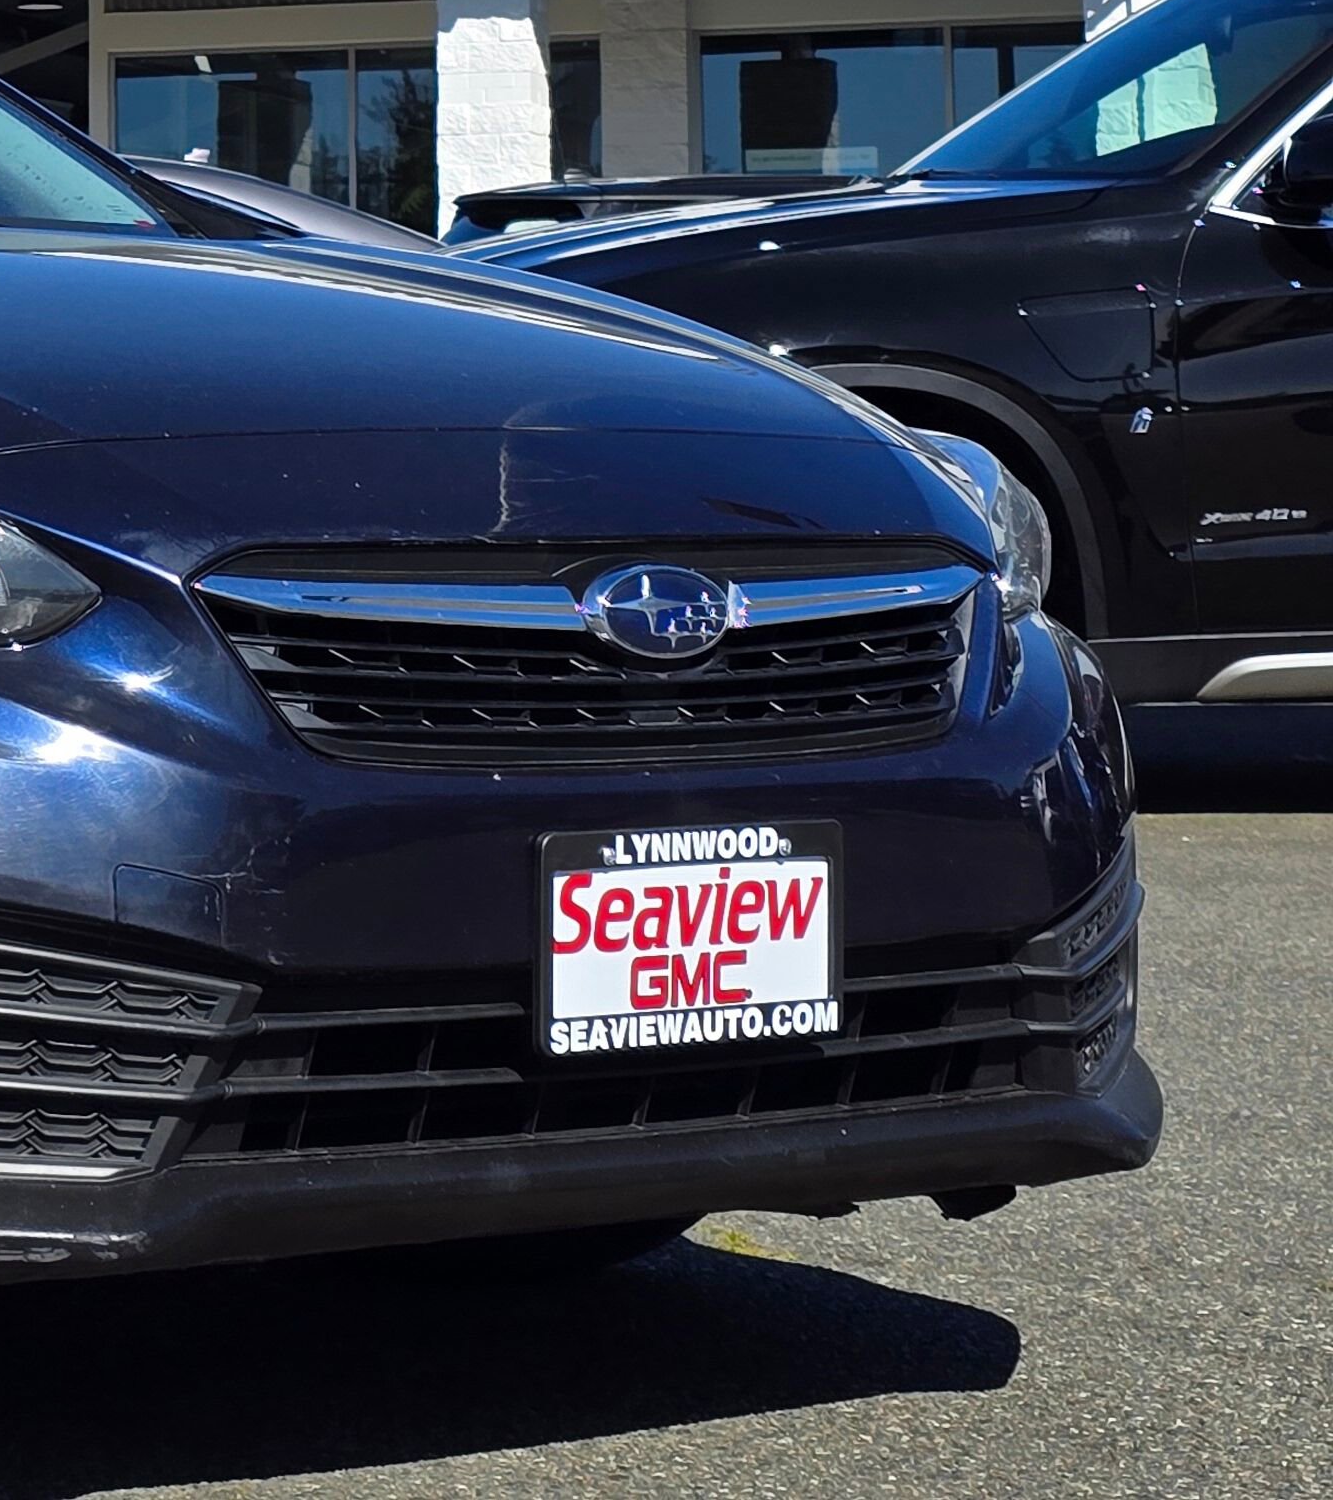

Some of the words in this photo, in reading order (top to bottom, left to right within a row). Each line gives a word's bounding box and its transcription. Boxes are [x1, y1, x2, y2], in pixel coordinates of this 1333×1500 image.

[613, 827, 780, 865] LYNNWOOD
[551, 867, 824, 955] Seaview
[629, 950, 749, 1011] GMC
[549, 1001, 839, 1056] SEAVIEWAUTO.COM
